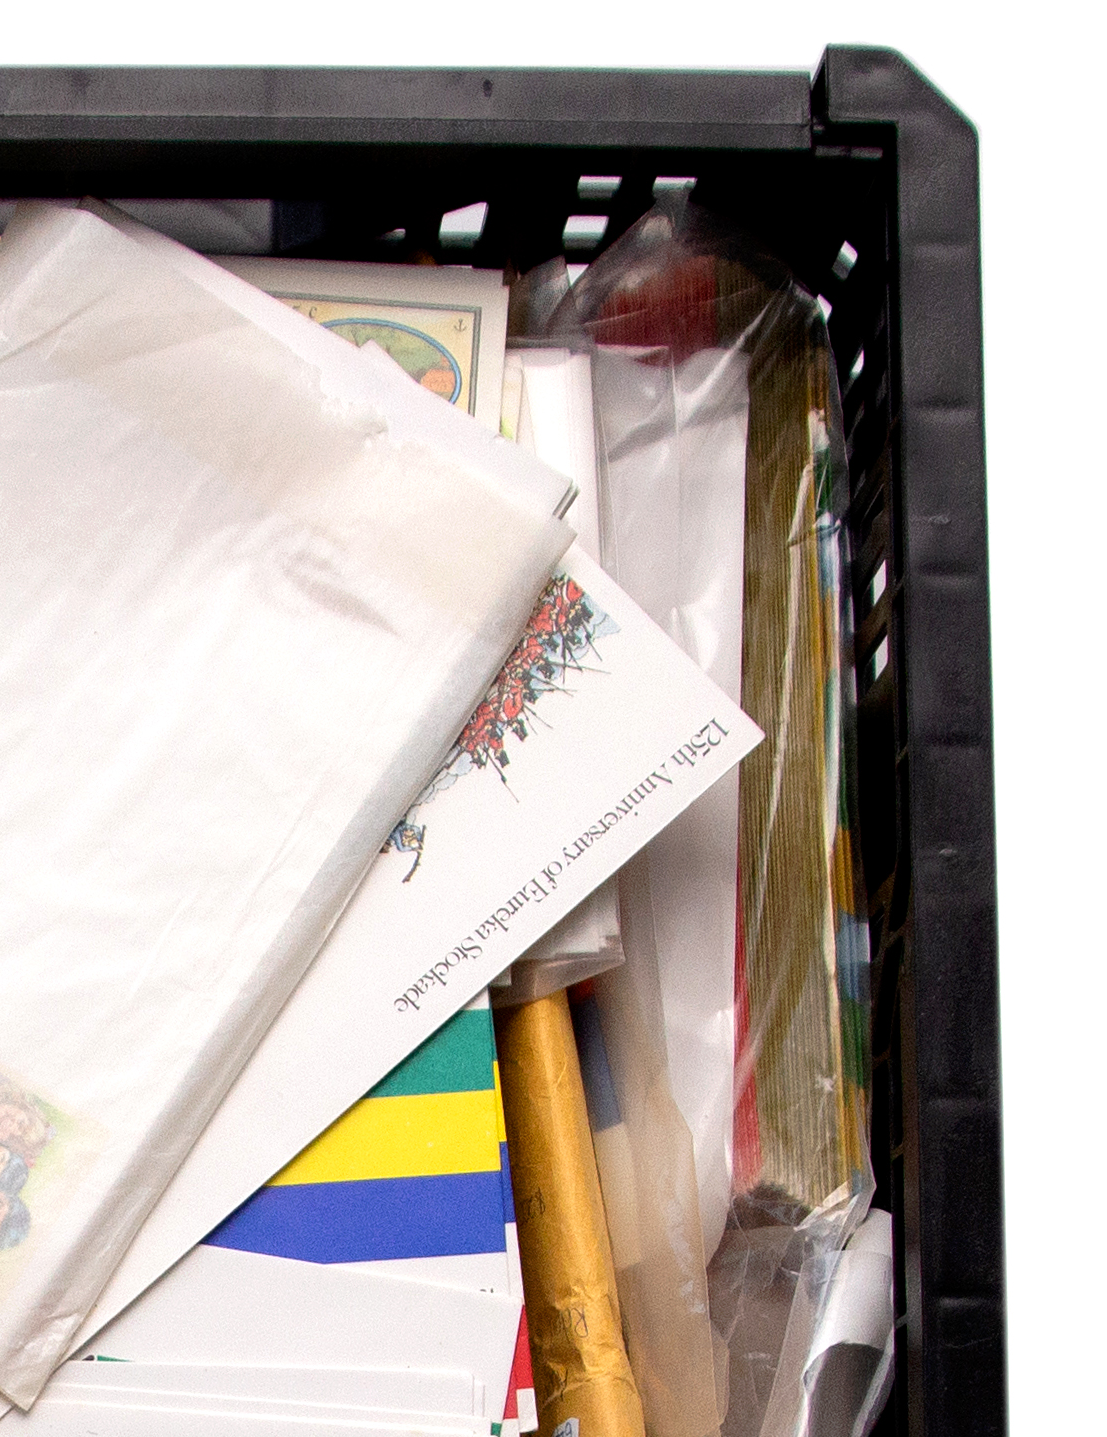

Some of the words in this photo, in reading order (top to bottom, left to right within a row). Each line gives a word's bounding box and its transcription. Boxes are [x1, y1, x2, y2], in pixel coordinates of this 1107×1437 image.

[671, 717, 731, 770] 125th
[561, 763, 675, 867] Anniversary
[542, 860, 565, 891] of
[474, 877, 552, 942] Eureka
[393, 936, 484, 1014] Stockade
